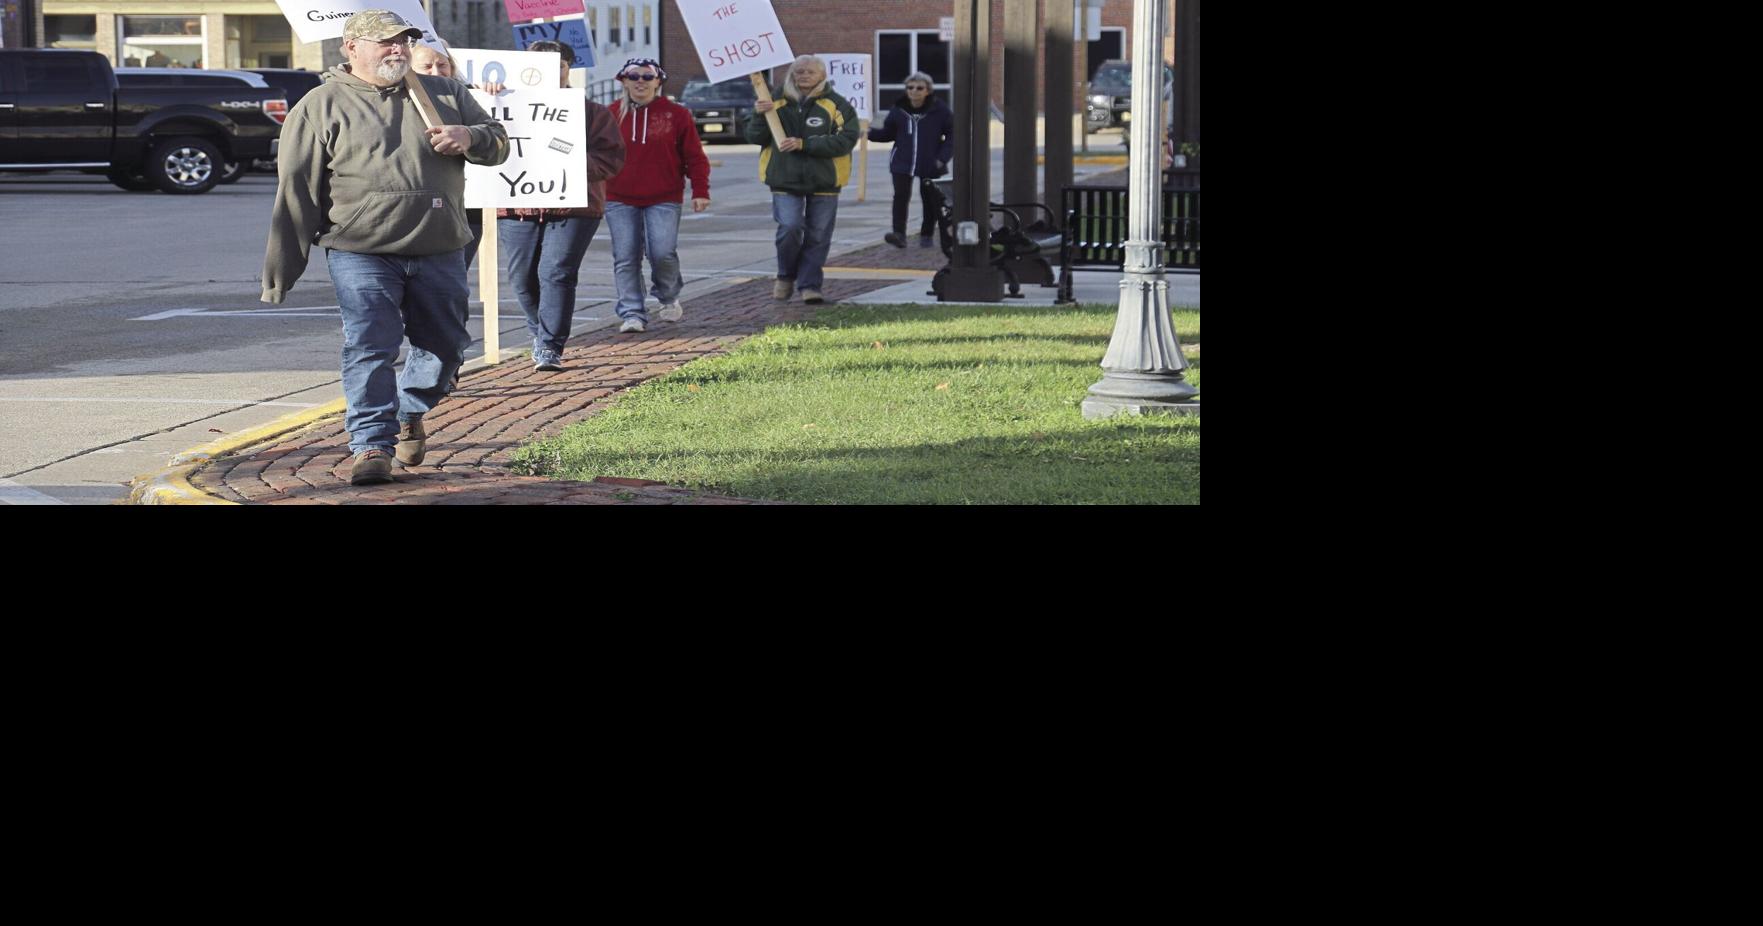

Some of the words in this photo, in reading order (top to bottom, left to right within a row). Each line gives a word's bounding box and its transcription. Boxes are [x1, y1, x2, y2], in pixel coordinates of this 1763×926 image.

[713, 3, 738, 20] THE
[709, 32, 775, 67] SHOT
[528, 103, 569, 122] THE
